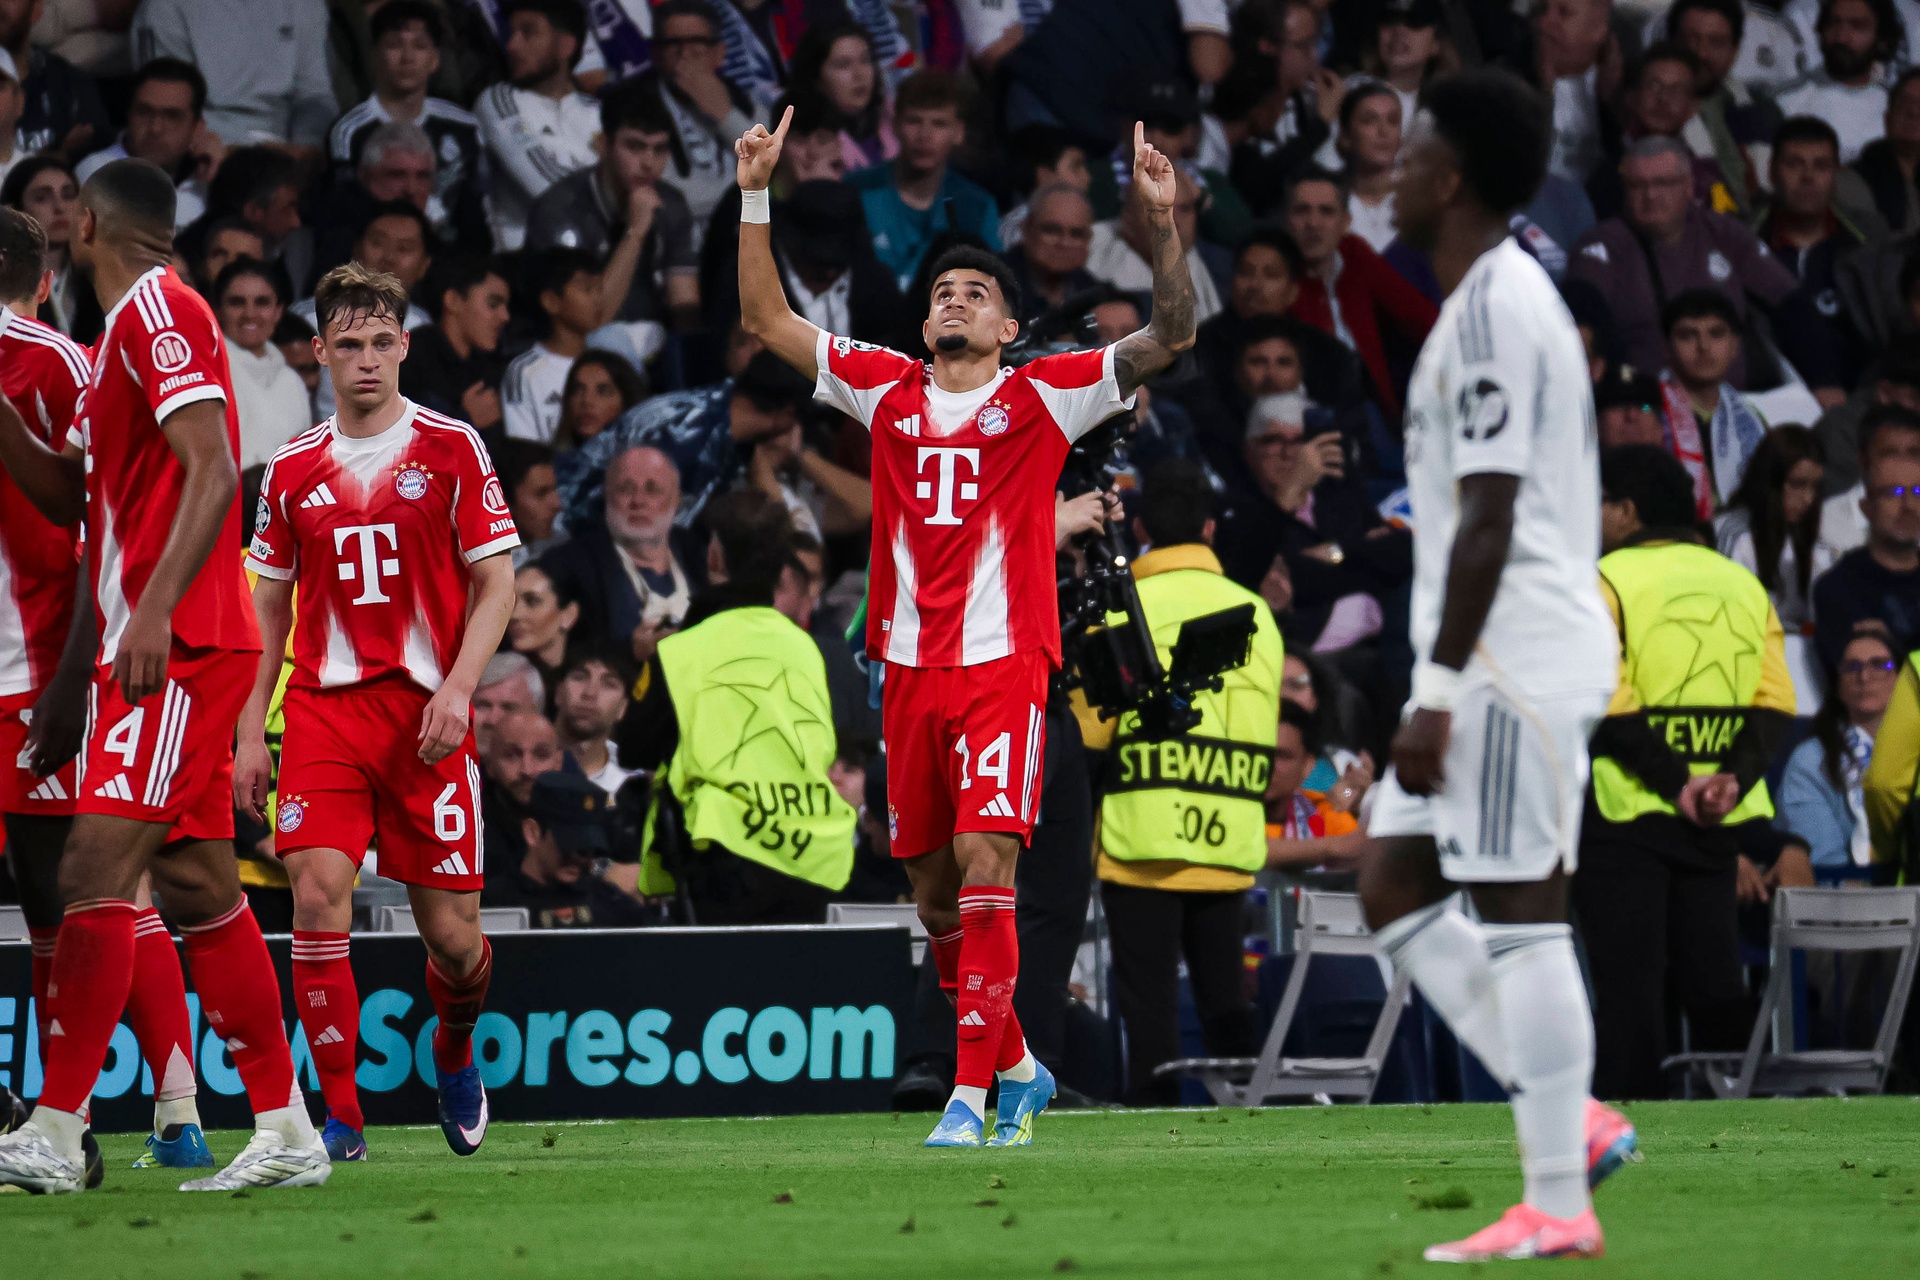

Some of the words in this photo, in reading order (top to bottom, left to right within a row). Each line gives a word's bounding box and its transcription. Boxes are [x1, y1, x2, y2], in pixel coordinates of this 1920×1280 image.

[159, 372, 205, 396] Allianz
[489, 518, 516, 535] Allia
[104, 706, 145, 767] 4
[955, 732, 1011, 790] 14
[1119, 740, 1269, 793] STEWARD
[433, 784, 466, 841] 6
